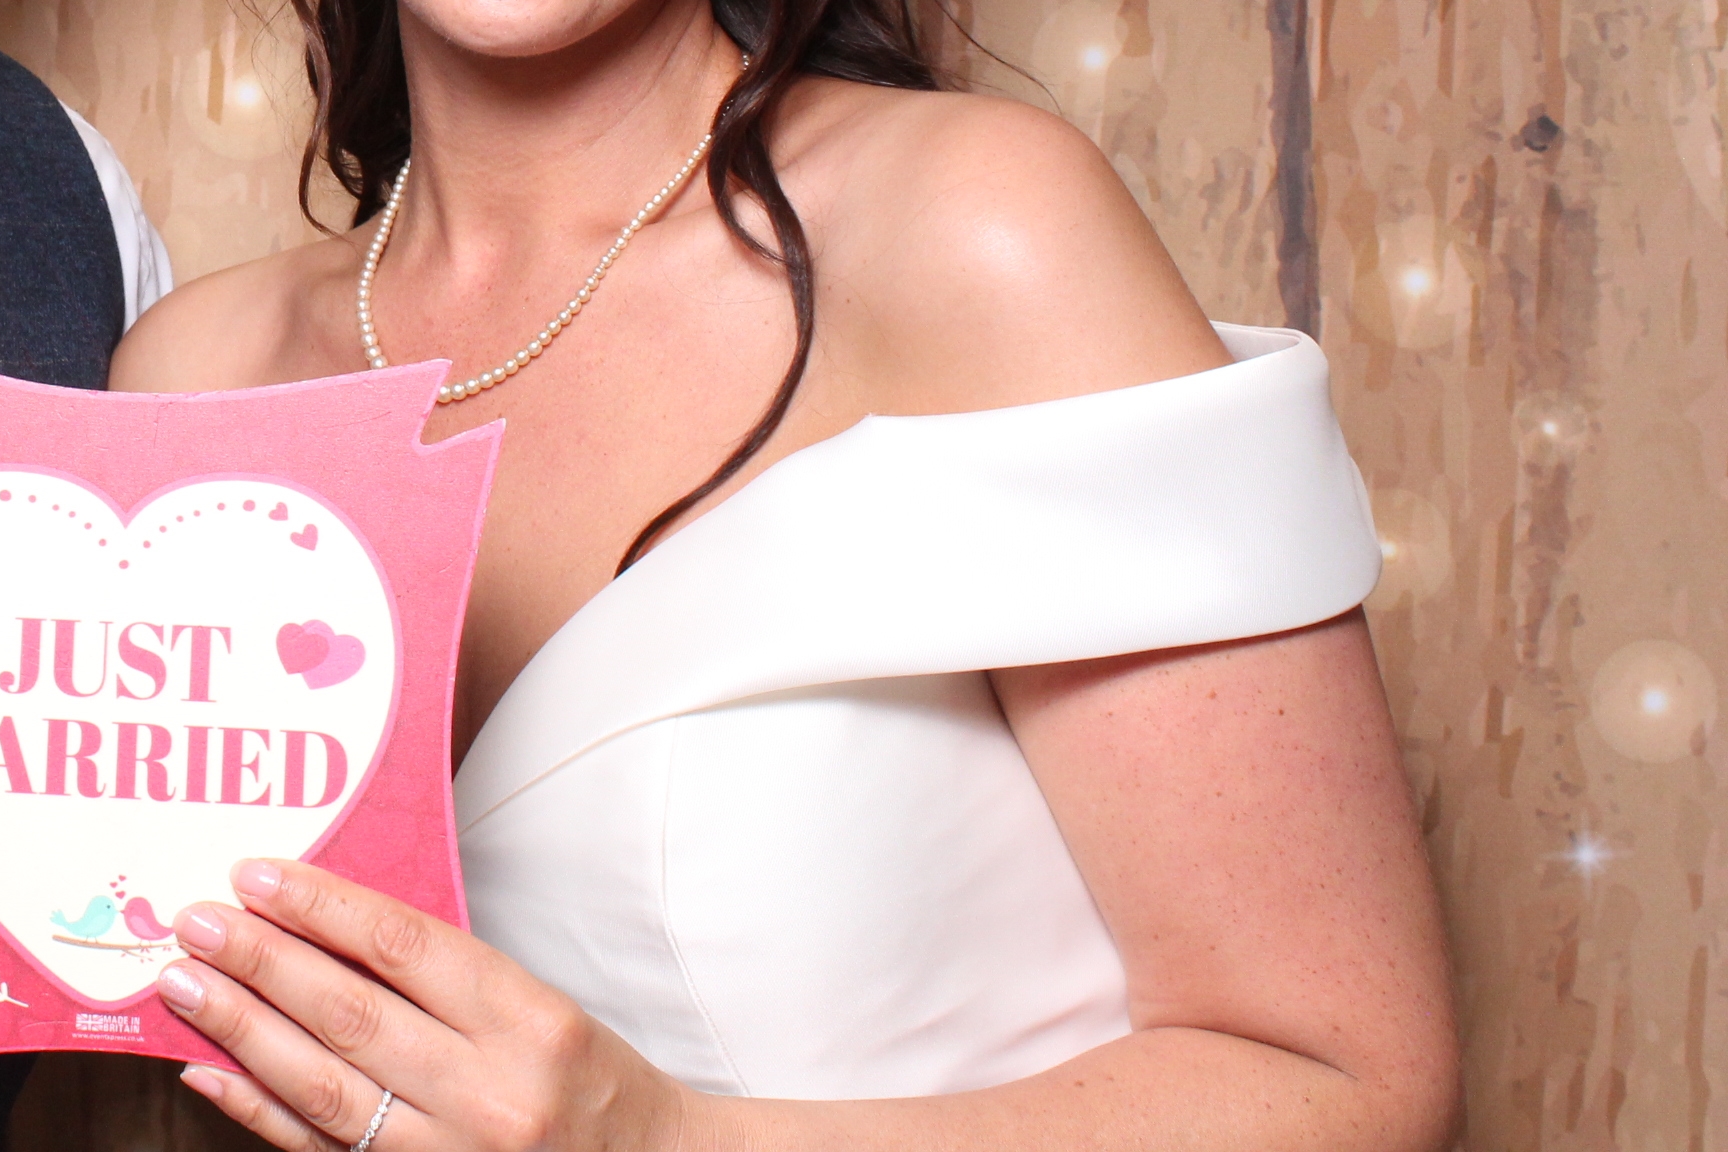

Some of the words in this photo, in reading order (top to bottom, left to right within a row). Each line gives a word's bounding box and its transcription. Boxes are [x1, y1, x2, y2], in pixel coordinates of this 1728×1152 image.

[103, 1015, 129, 1025] MADE
[131, 1016, 140, 1025] IN
[103, 1023, 140, 1033] BRITAIN
